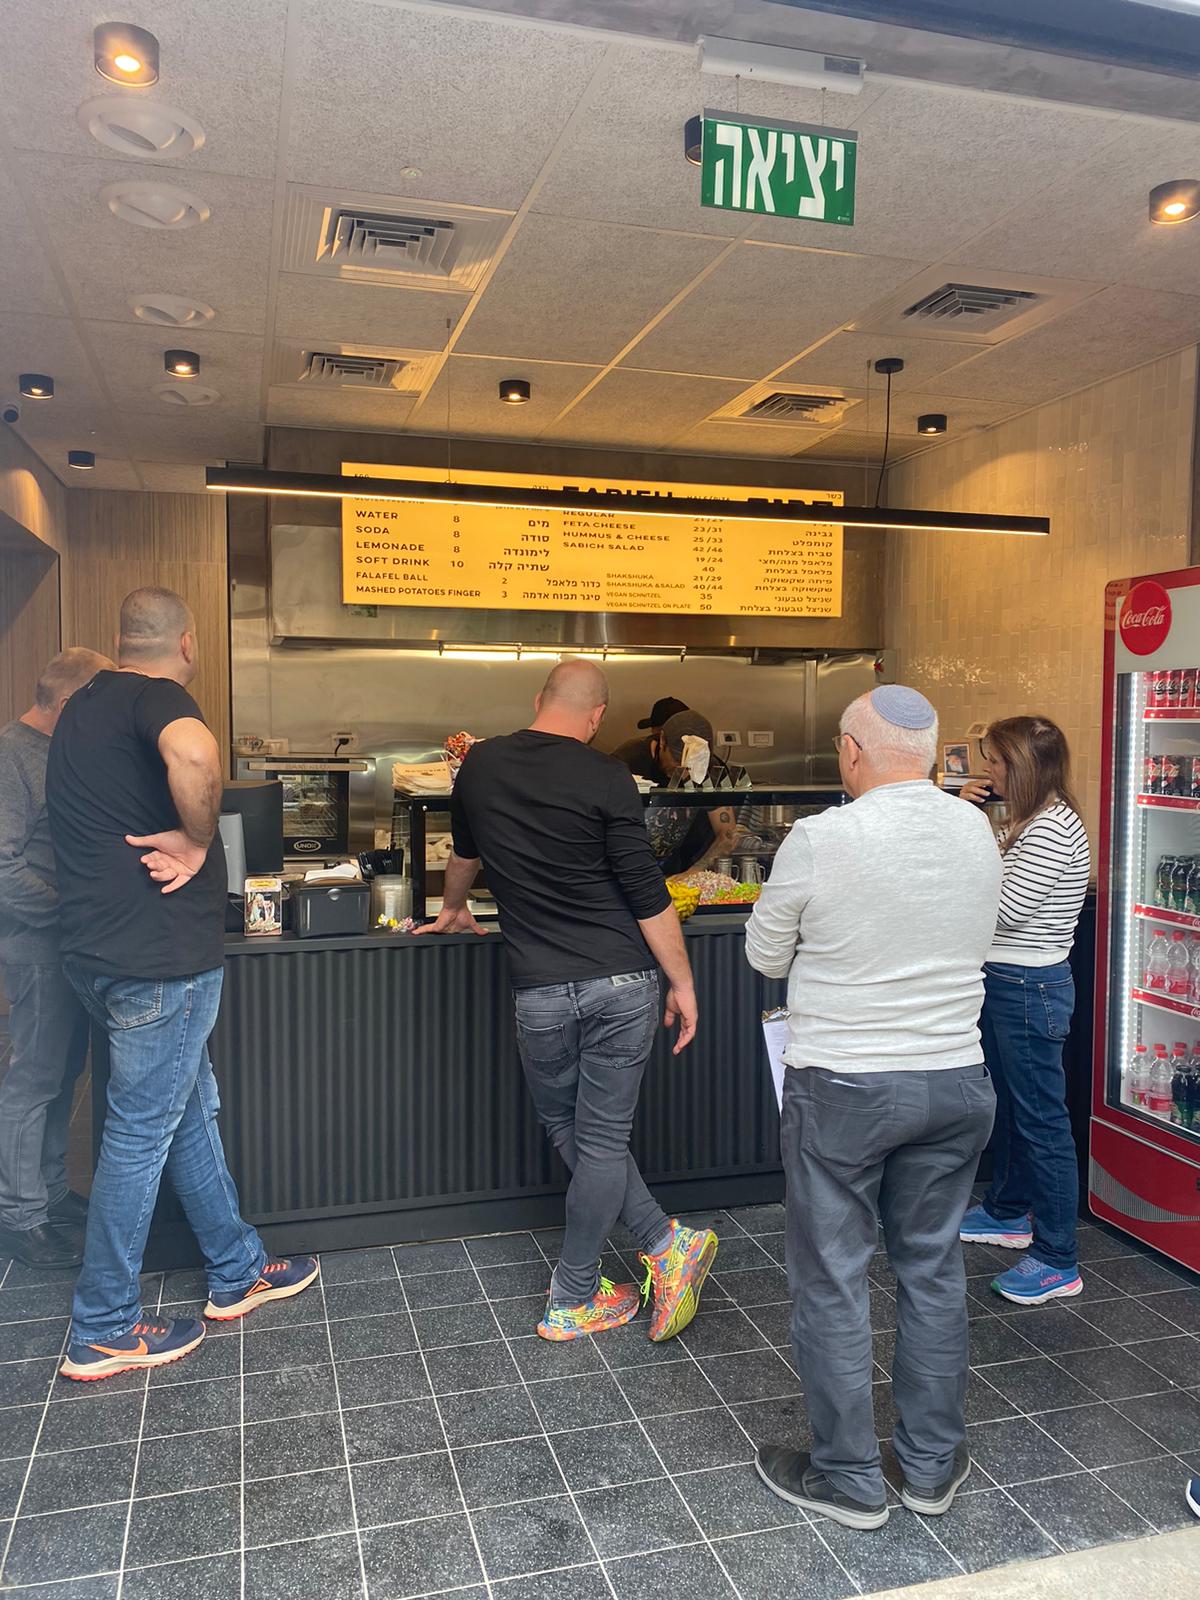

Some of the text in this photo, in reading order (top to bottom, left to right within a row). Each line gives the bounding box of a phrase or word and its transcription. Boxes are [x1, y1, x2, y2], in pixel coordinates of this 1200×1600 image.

[715, 124, 845, 219] יציאה
[356, 511, 398, 520] WATER
[453, 516, 460, 524] 8
[529, 520, 549, 528] מים
[356, 526, 389, 535] SODA
[453, 531, 460, 539] 8
[522, 535, 549, 543] סודה
[357, 542, 424, 552] LEMONADE
[793, 540, 832, 548] קומפלט
[454, 546, 460, 554] 8
[504, 549, 549, 558] לימונדה
[357, 556, 429, 567] SOFT DRINK
[489, 561, 549, 572] שתיה קלה
[356, 572, 427, 582] FALAFEL BALL
[547, 579, 577, 588] פלאפל
[357, 586, 396, 594] MASHED
[399, 587, 445, 596] POTATOES
[502, 591, 507, 599] 3
[523, 592, 549, 600] אדמה
[553, 593, 577, 601] תפוח
[807, 596, 831, 604] שניצל
[806, 606, 831, 614] שניצל
